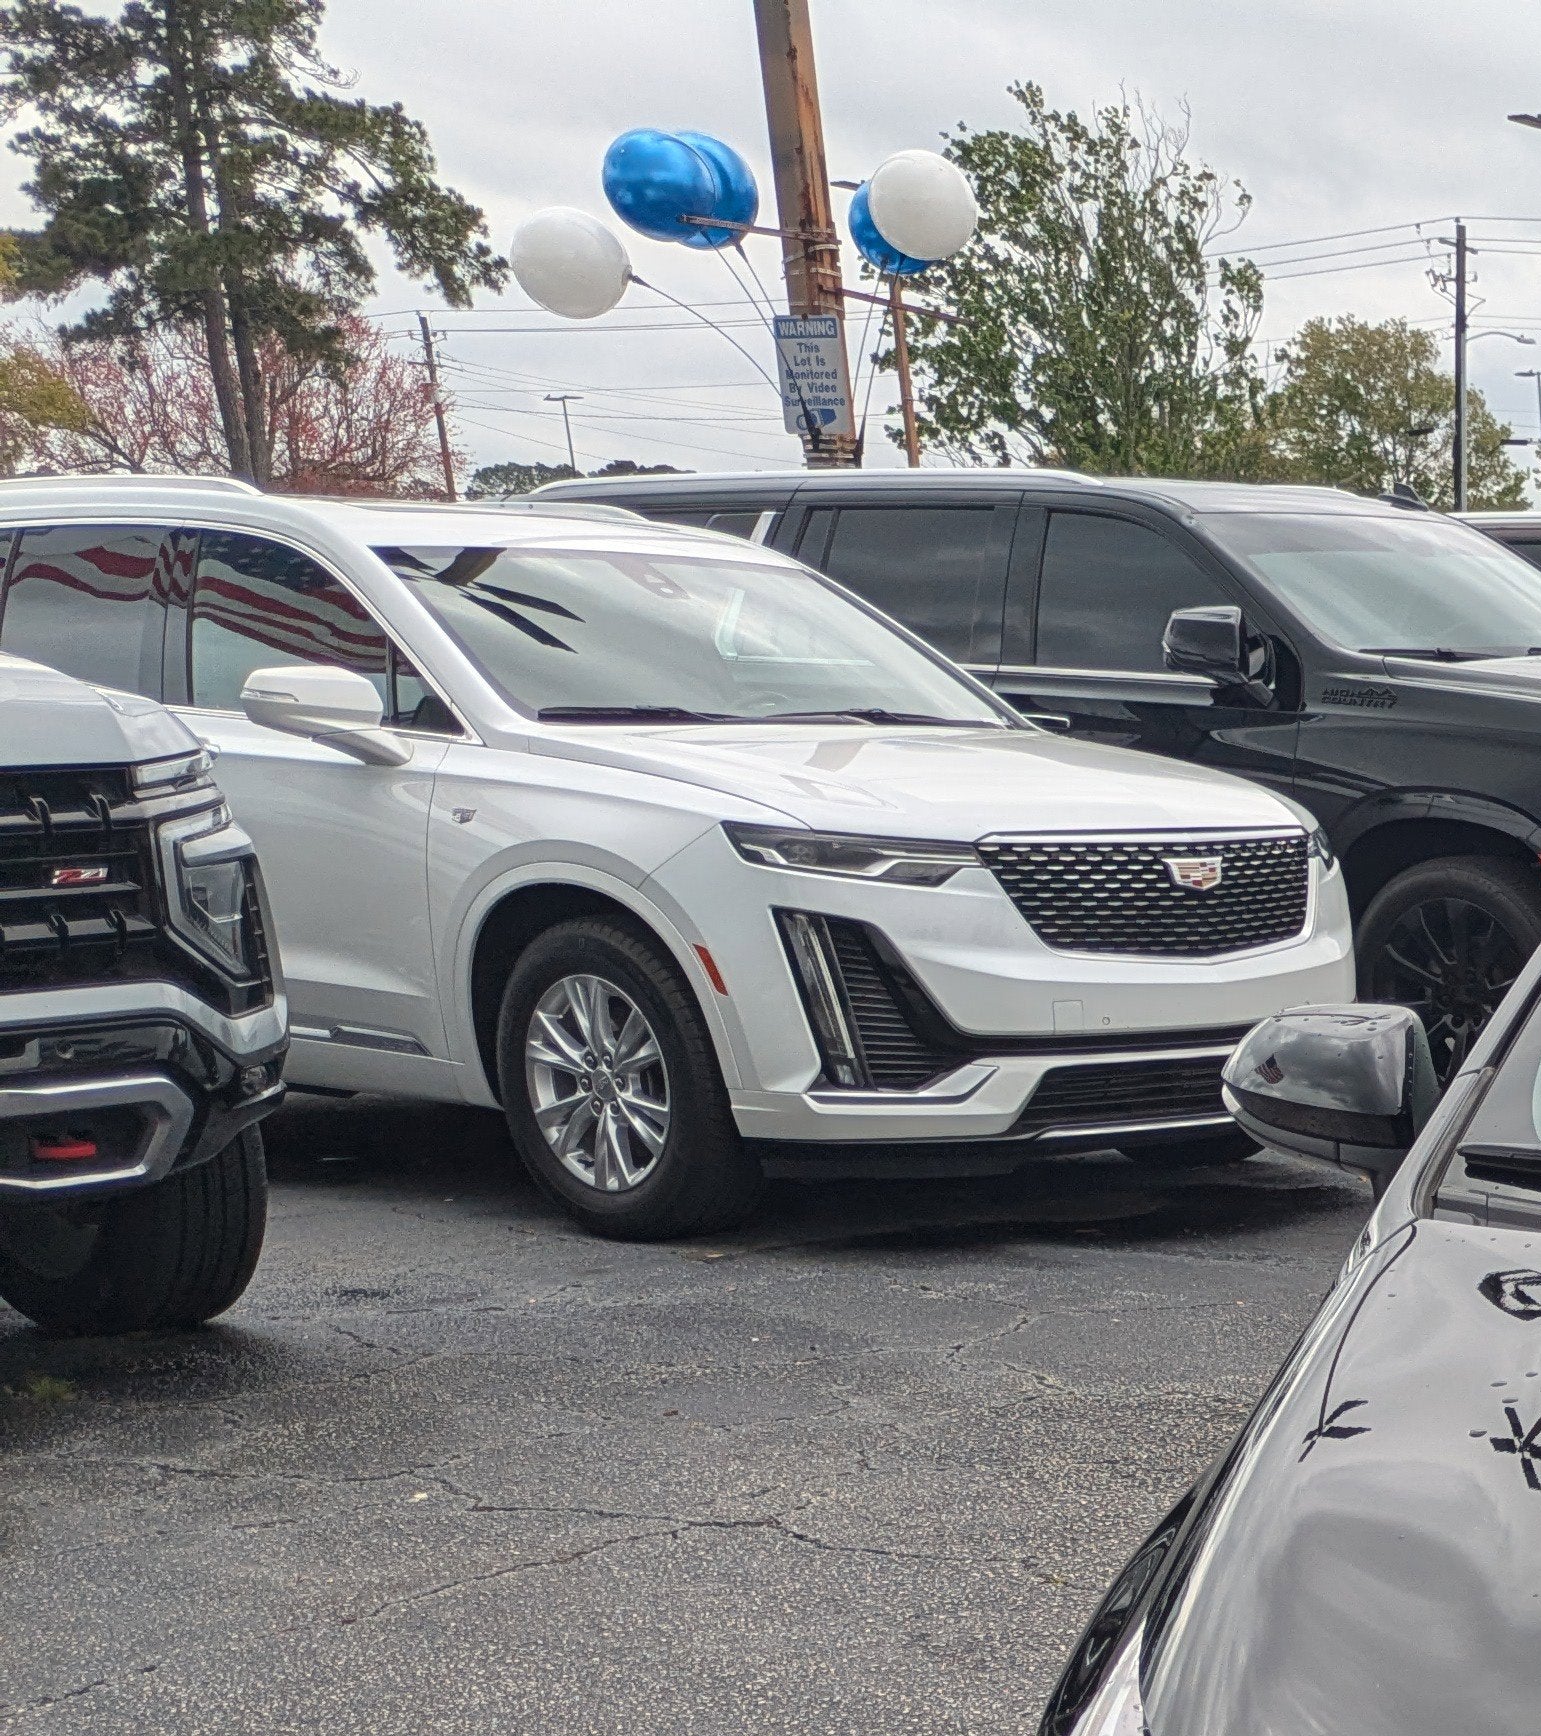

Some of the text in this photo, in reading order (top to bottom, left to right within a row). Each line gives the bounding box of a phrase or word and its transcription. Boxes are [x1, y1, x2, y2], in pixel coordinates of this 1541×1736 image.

[778, 320, 837, 337] WARNING
[797, 342, 823, 354] This
[793, 355, 827, 367] Lot Is
[786, 368, 838, 381] Monitored
[807, 382, 838, 394] Video
[52, 867, 109, 885] Z71
